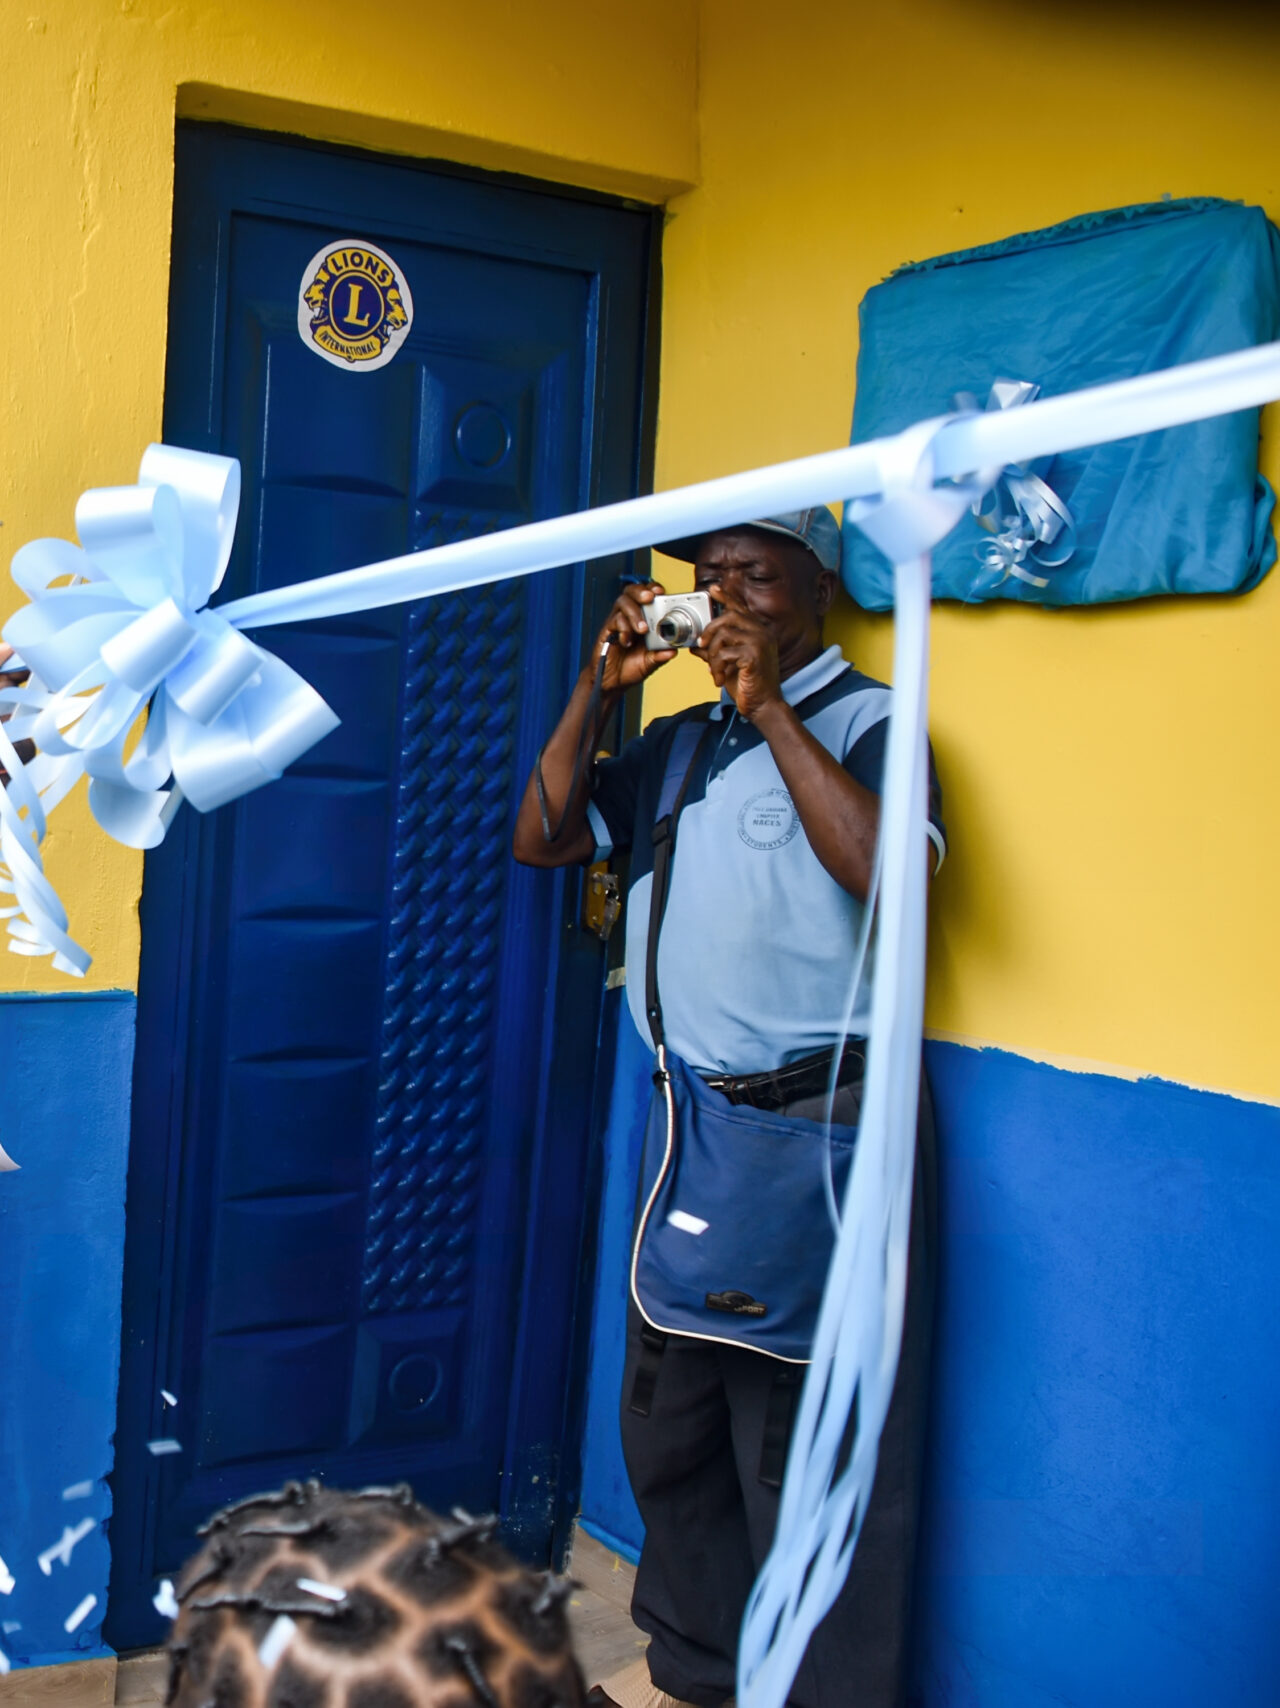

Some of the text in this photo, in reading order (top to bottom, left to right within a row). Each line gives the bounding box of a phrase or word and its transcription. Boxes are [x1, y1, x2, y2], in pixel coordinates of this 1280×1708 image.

[331, 252, 390, 283] LIONS
[343, 283, 371, 327] L
[320, 331, 377, 357] INTERNATIONAL
